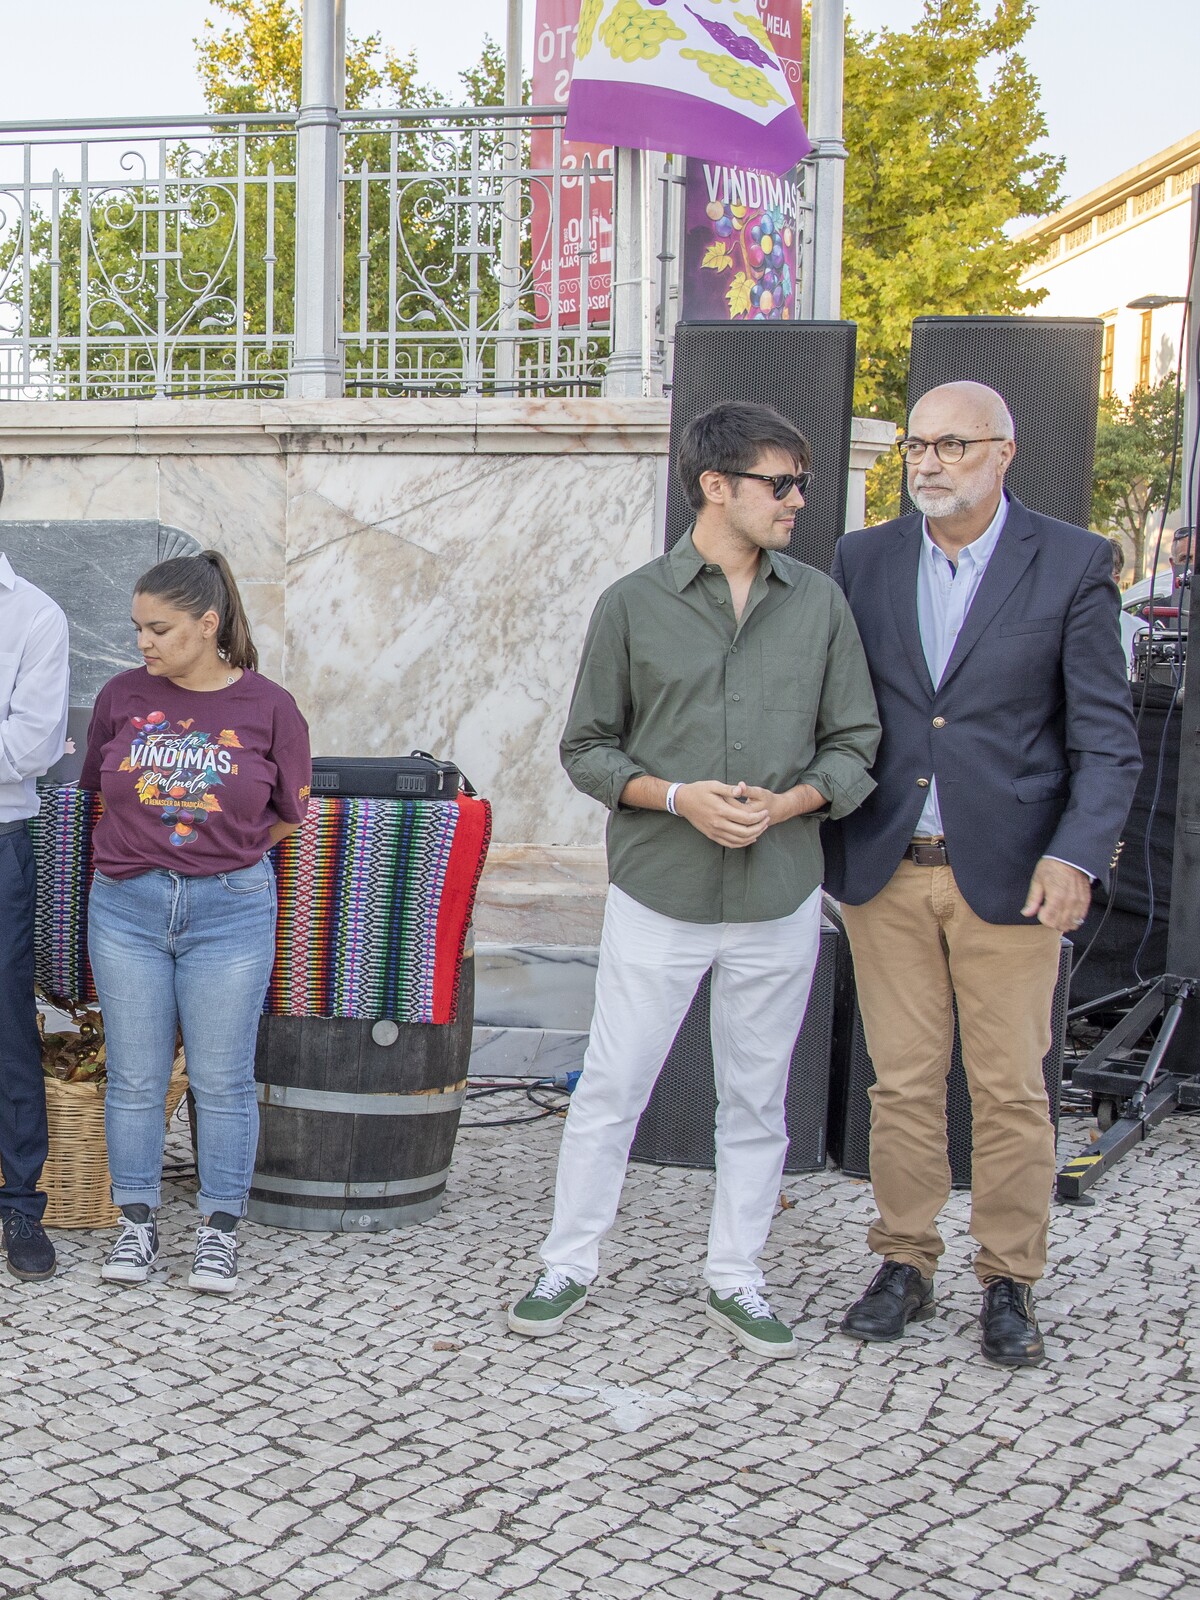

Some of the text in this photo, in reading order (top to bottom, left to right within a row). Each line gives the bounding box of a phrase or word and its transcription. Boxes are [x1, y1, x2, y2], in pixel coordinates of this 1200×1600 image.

[703, 164, 797, 220] VINDIMAS
[147, 733, 201, 751] Festa
[130, 744, 231, 774] VINDIMAS
[141, 770, 210, 794] Palmela
